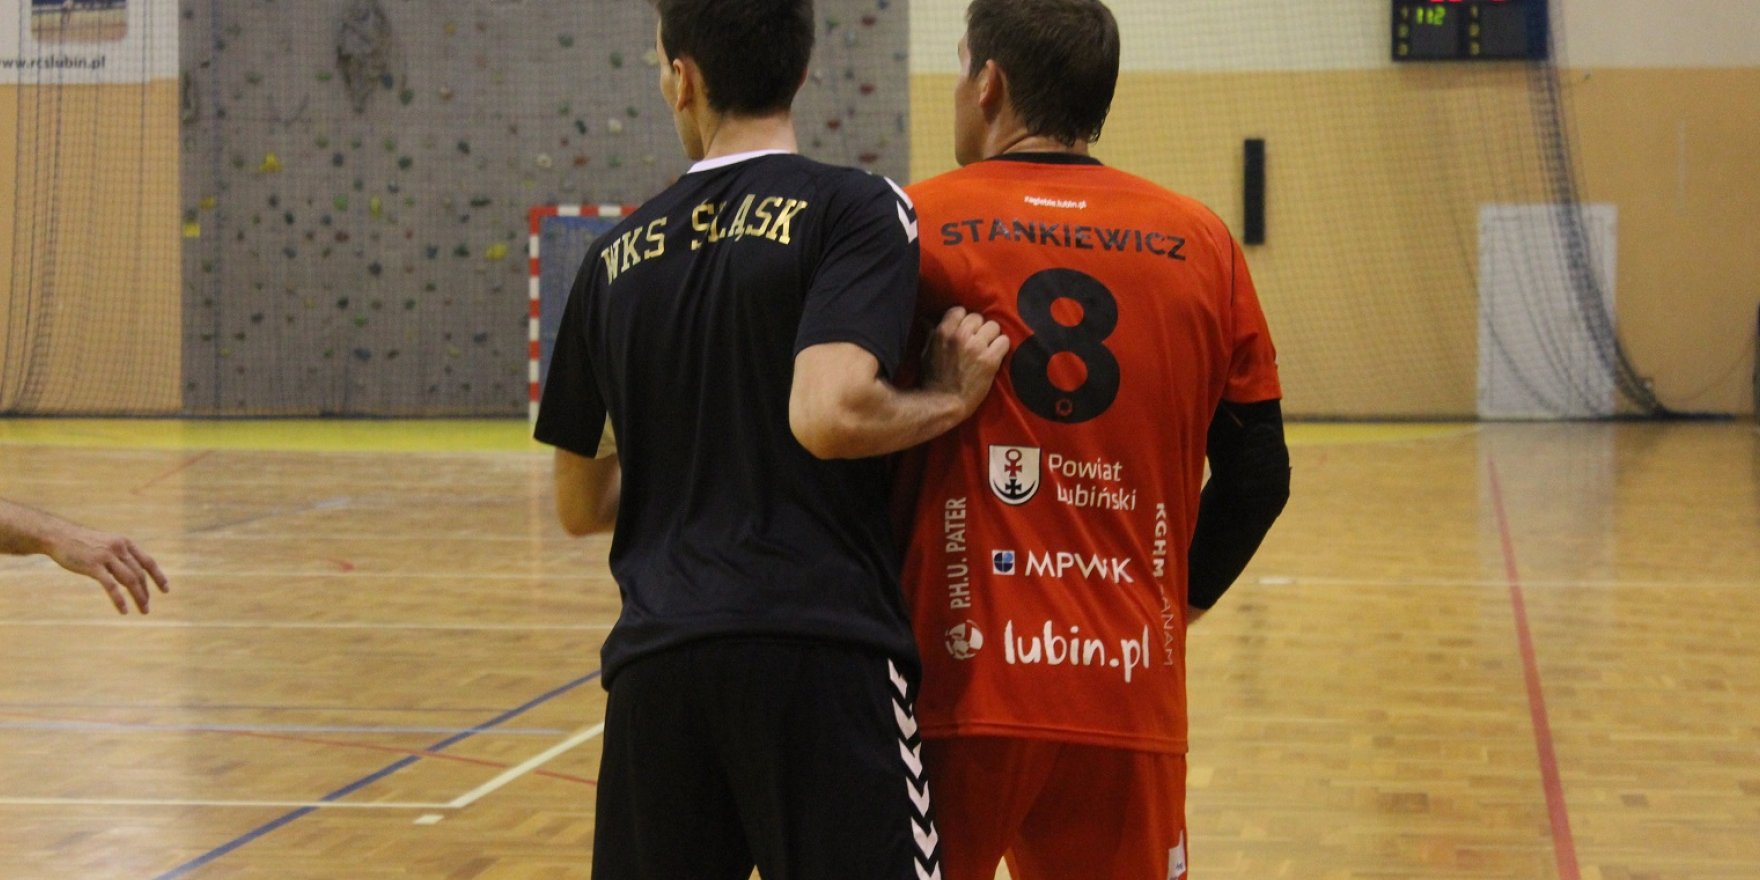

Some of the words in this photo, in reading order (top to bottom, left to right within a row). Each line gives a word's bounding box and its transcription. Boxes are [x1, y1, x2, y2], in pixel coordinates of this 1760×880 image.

[0, 54, 105, 70] ww.rcslubin.pl
[601, 217, 667, 285] WKS
[941, 218, 1187, 261] STANKIEWICZ
[1010, 267, 1120, 424] 8
[1048, 454, 1123, 482] Powiat
[1057, 483, 1137, 511] Lubiński
[945, 497, 966, 553] PATER
[1152, 503, 1167, 577] KGHM
[947, 558, 971, 609] P.H.U.
[1004, 619, 1150, 684] lubin.pl
